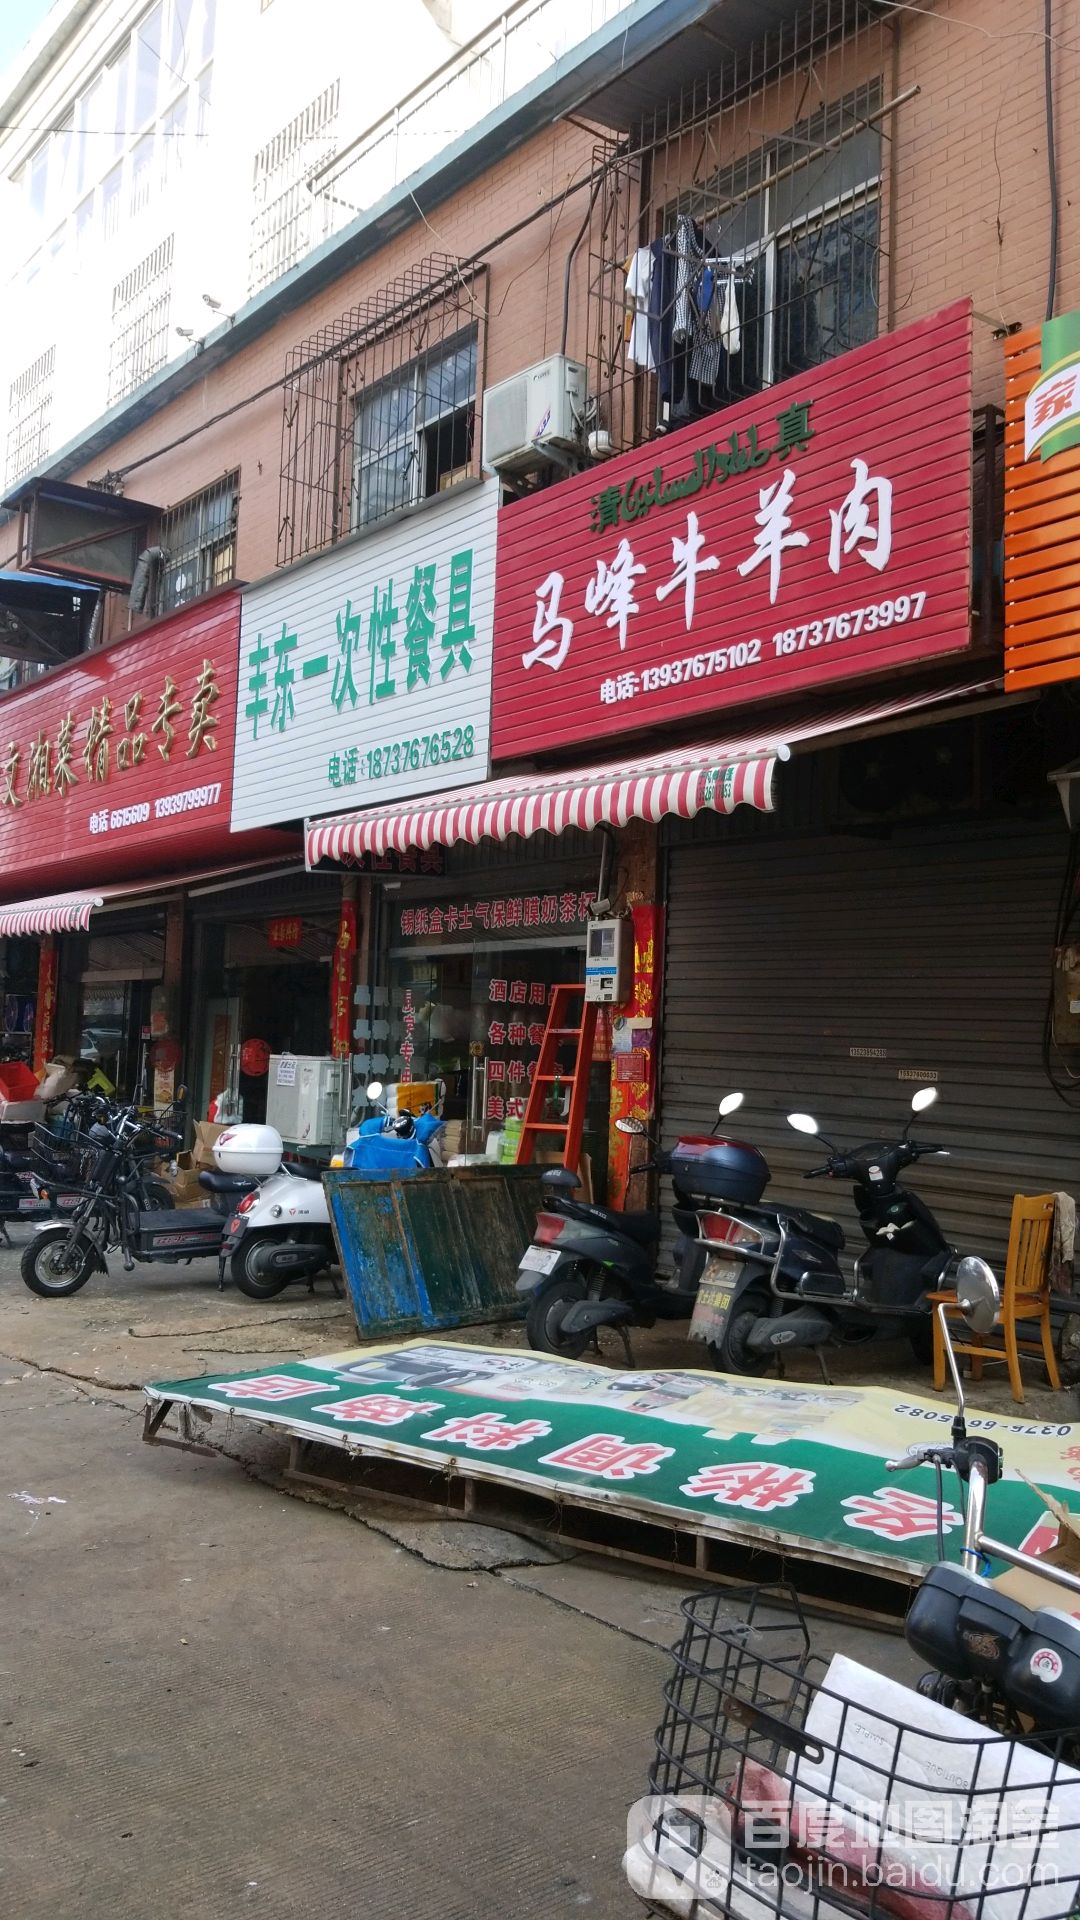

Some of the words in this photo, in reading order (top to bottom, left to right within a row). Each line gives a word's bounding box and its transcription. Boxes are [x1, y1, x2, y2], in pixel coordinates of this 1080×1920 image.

[773, 398, 816, 460] 真
[590, 485, 623, 533] 清
[522, 458, 893, 671] 马峰牛羊肉
[245, 547, 475, 740] 丰东一次性餐具
[772, 592, 928, 656] 18737673997
[89, 808, 109, 834] 电话
[110, 802, 150, 829] 6615609
[154, 783, 222, 818] 13939799977
[400, 891, 597, 936] 锡纸盒卡士气保鲜膜奶茶杯
[489, 978, 558, 1006] 酒店用
[488, 1020, 548, 1047] 各种餐
[895, 1404, 1072, 1436] 0376-665082
